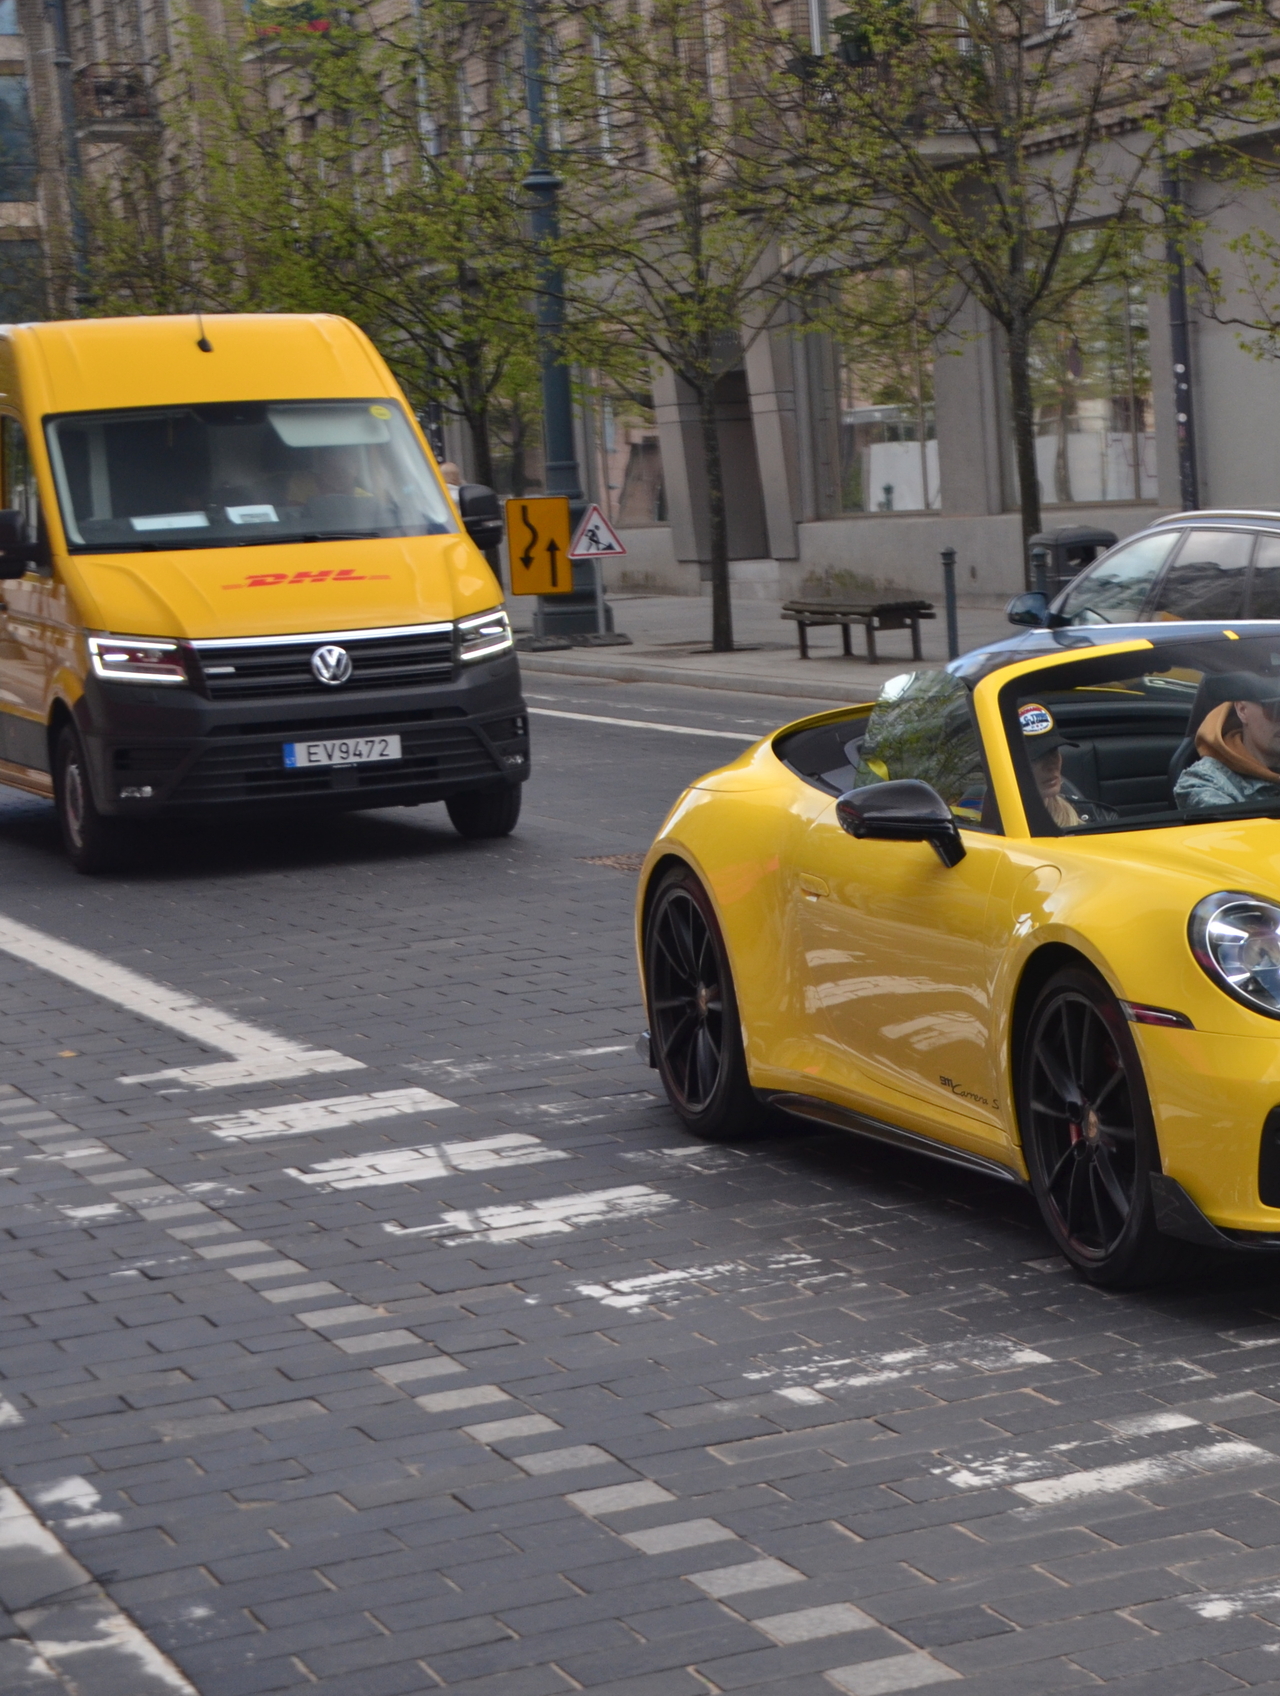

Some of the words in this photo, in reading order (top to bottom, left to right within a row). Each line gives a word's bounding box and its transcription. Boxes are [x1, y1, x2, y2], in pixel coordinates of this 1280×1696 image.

[245, 569, 367, 588] DHL
[306, 738, 390, 763] EV9472
[952, 1084, 988, 1105] Carrera
[992, 1099, 999, 1110] S
